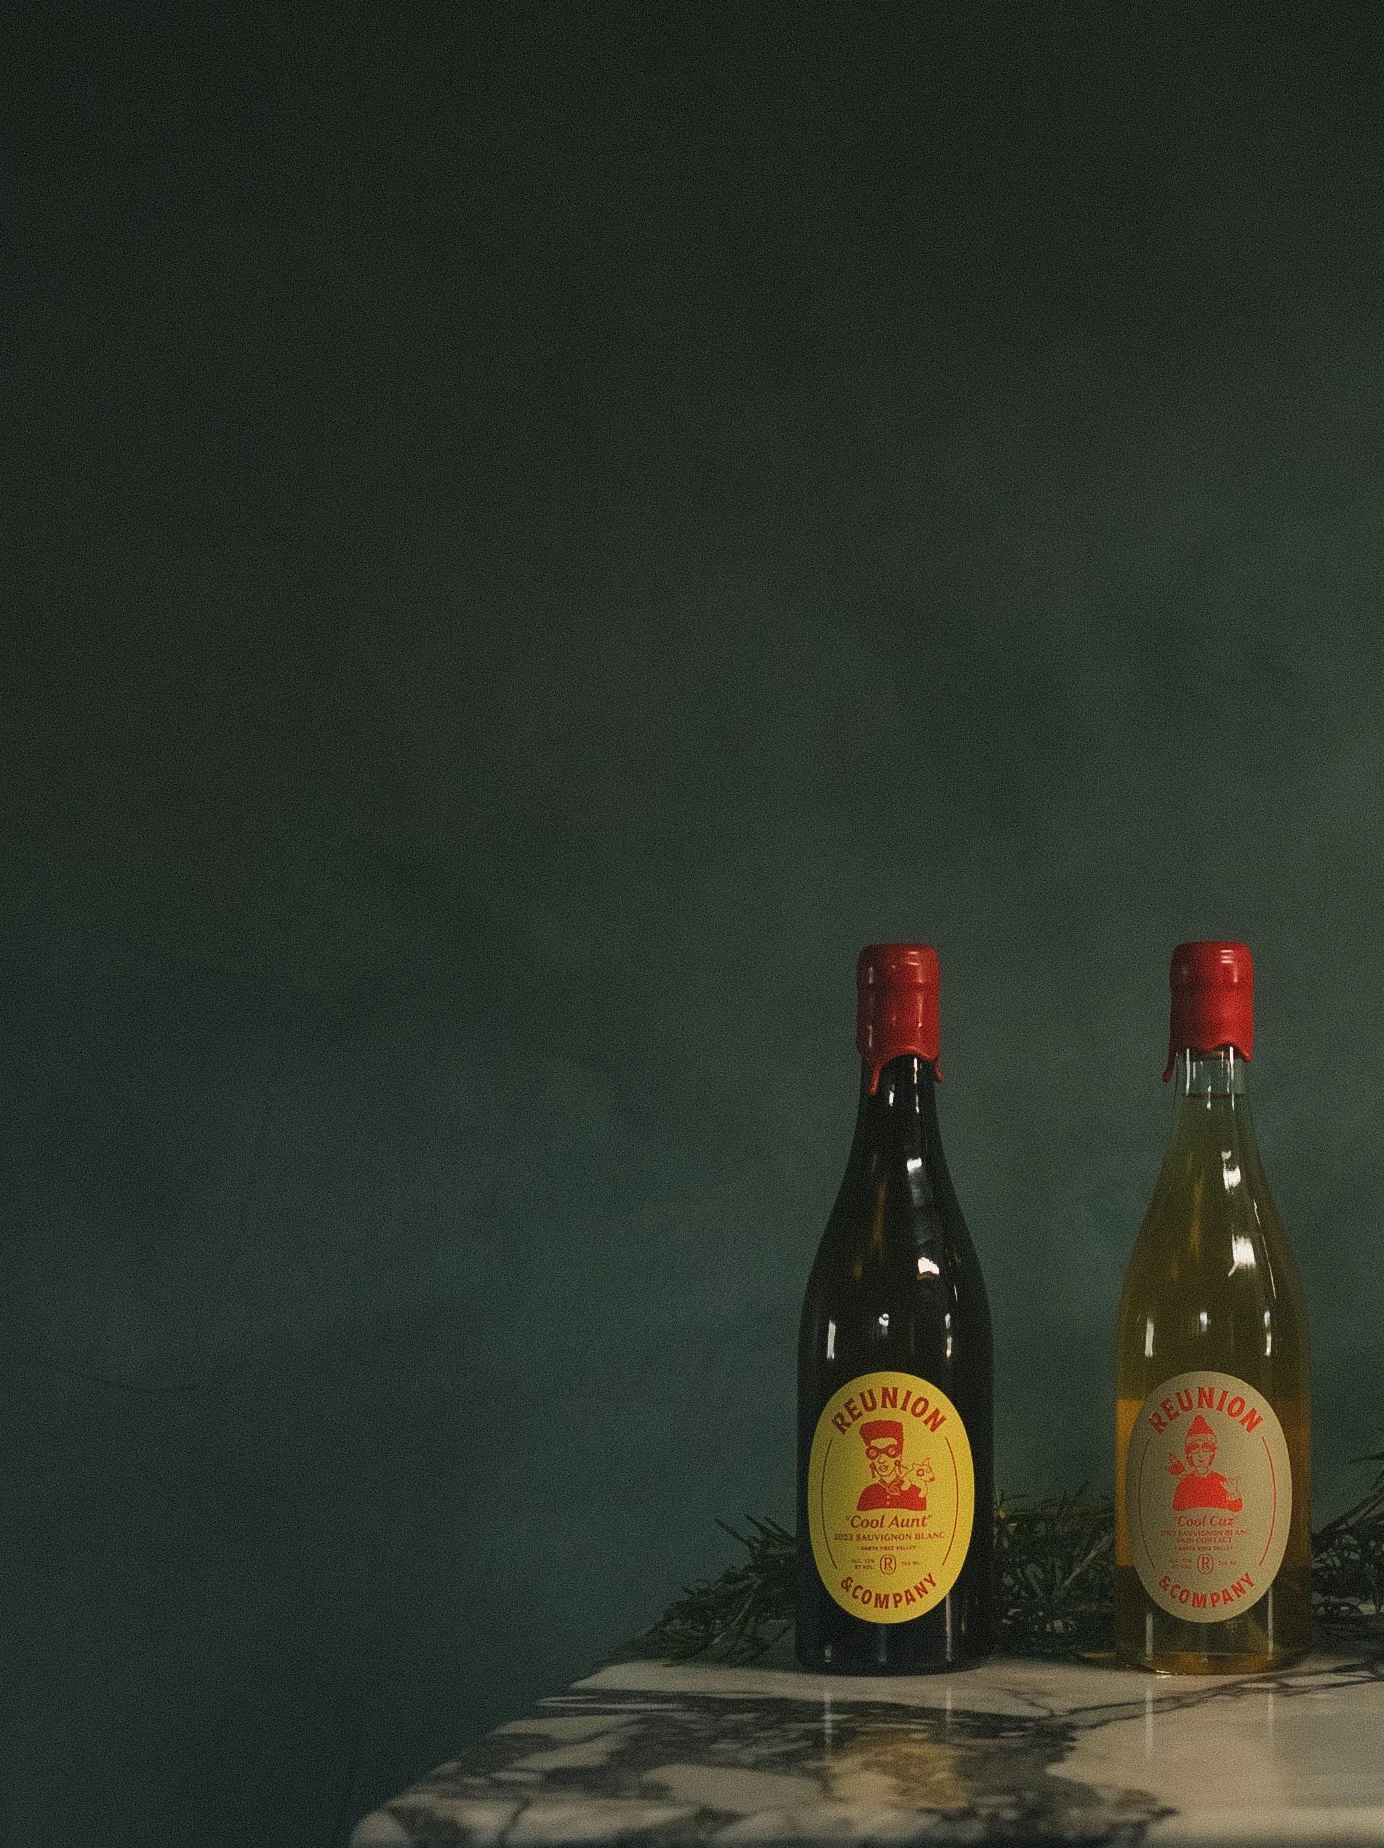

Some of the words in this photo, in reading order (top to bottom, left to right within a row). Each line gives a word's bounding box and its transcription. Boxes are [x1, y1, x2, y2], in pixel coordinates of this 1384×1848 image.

[831, 1387, 946, 1435] REUNION
[1148, 1386, 1264, 1435] REUNION
[855, 1533, 912, 1541] SAUVIGNON
[840, 1572, 938, 1610] &COMPANY
[1158, 1571, 1255, 1609] &COMPANY
